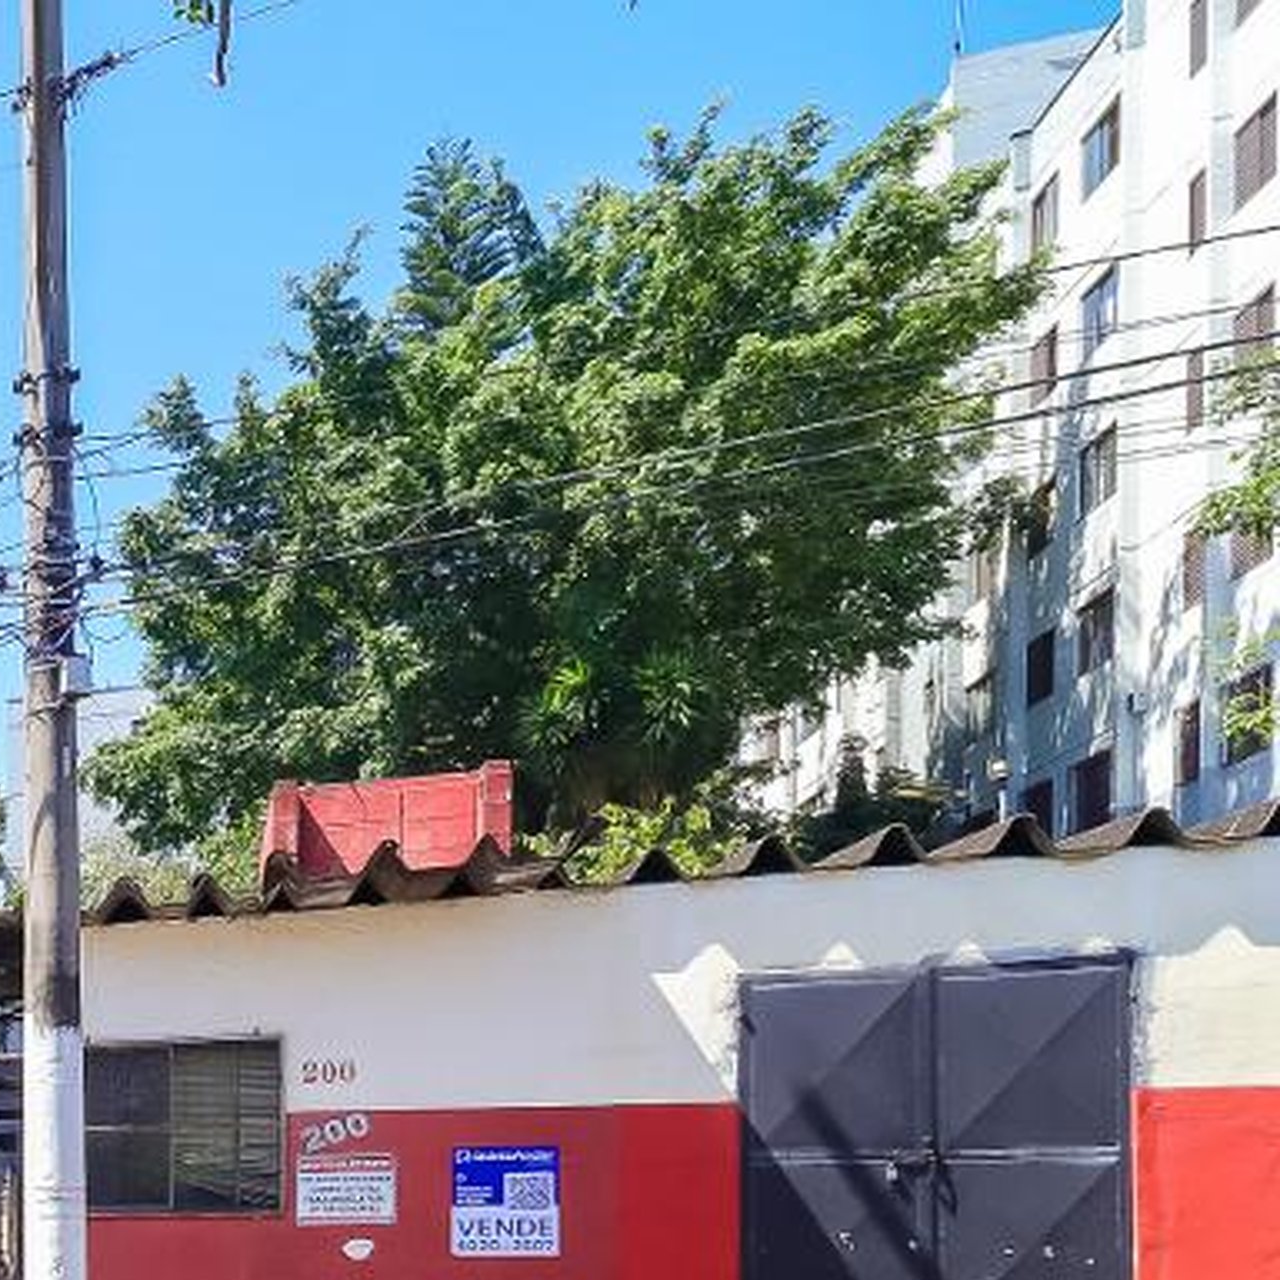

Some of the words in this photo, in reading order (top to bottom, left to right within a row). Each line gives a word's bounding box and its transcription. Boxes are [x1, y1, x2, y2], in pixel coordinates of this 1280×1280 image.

[301, 1060, 356, 1084] 200
[302, 1113, 368, 1155] 200
[457, 1218, 554, 1237] VENDE
